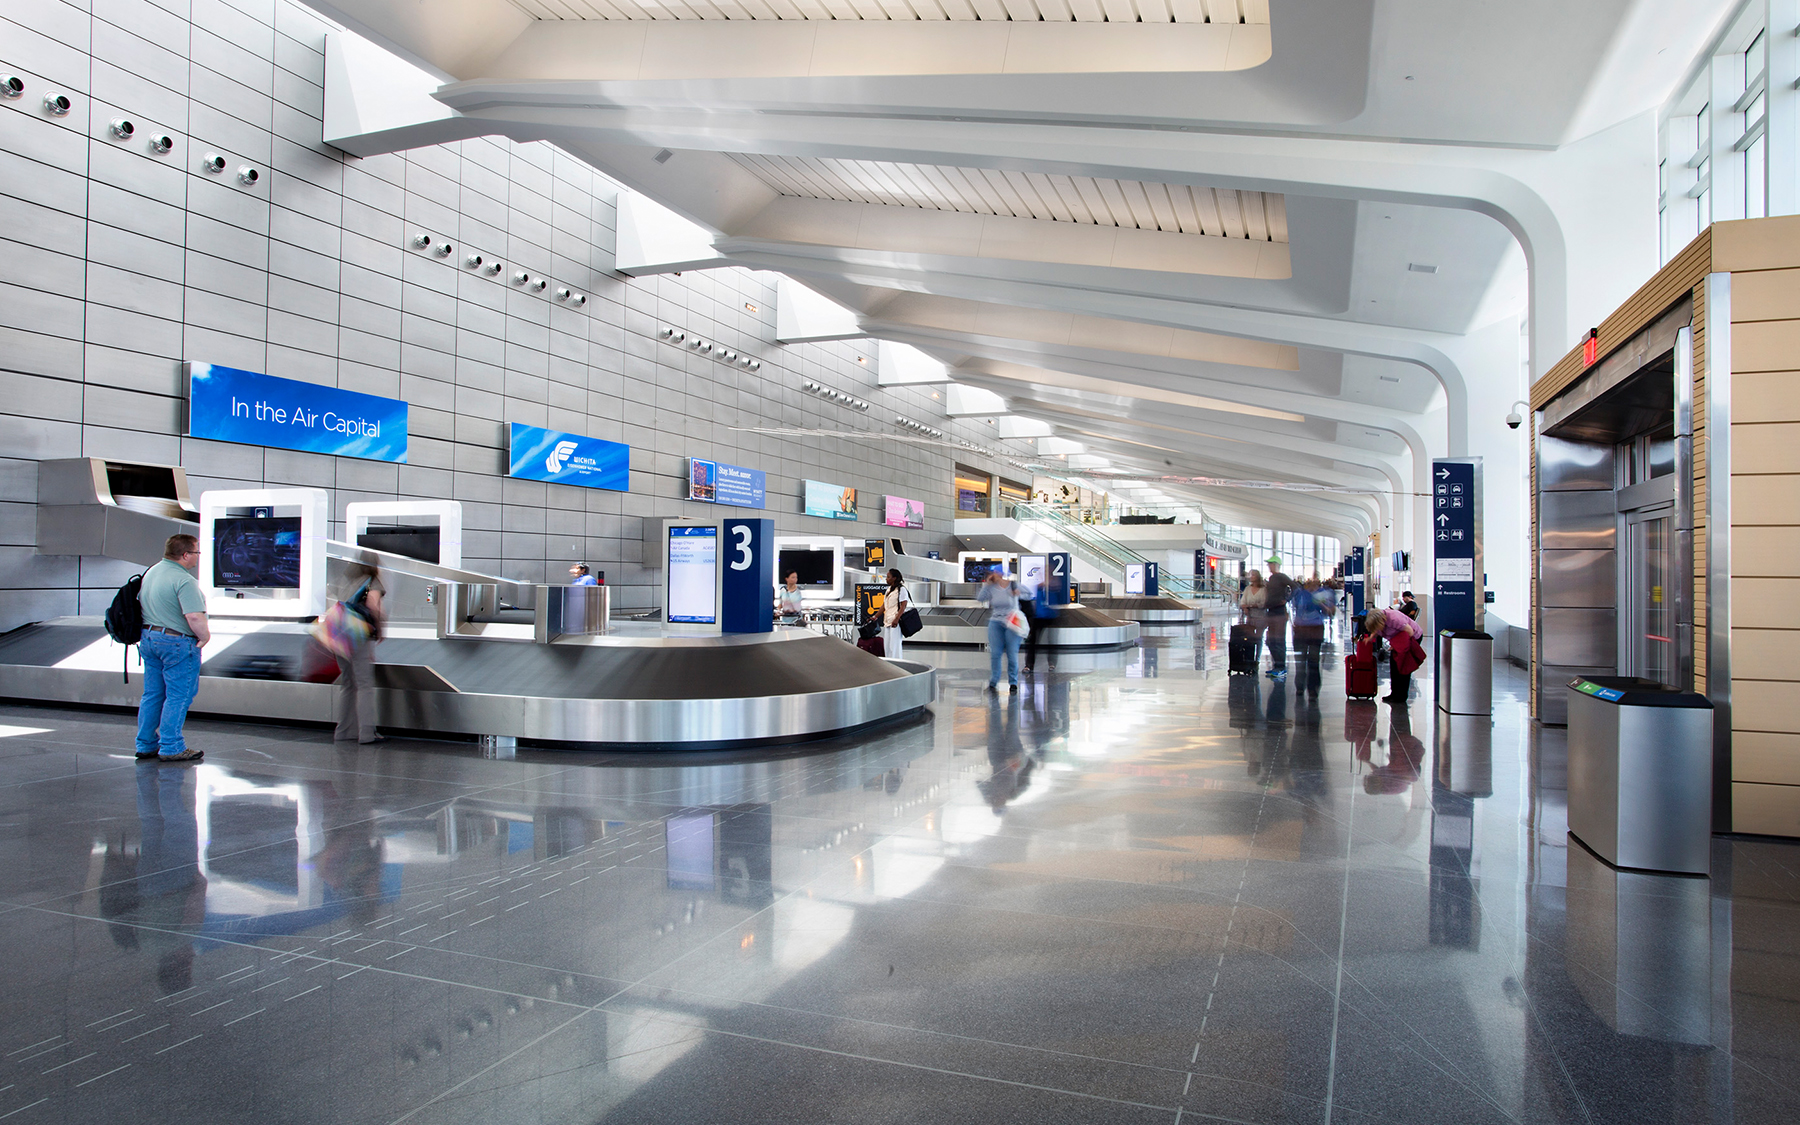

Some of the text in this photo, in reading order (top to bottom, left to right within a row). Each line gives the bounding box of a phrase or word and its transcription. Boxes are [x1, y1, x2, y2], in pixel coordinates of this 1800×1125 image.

[232, 396, 381, 438] In the Air Capital
[574, 456, 596, 465] WICHITA
[730, 525, 753, 571] 3
[1052, 555, 1064, 576] 2
[1149, 564, 1155, 578] 1
